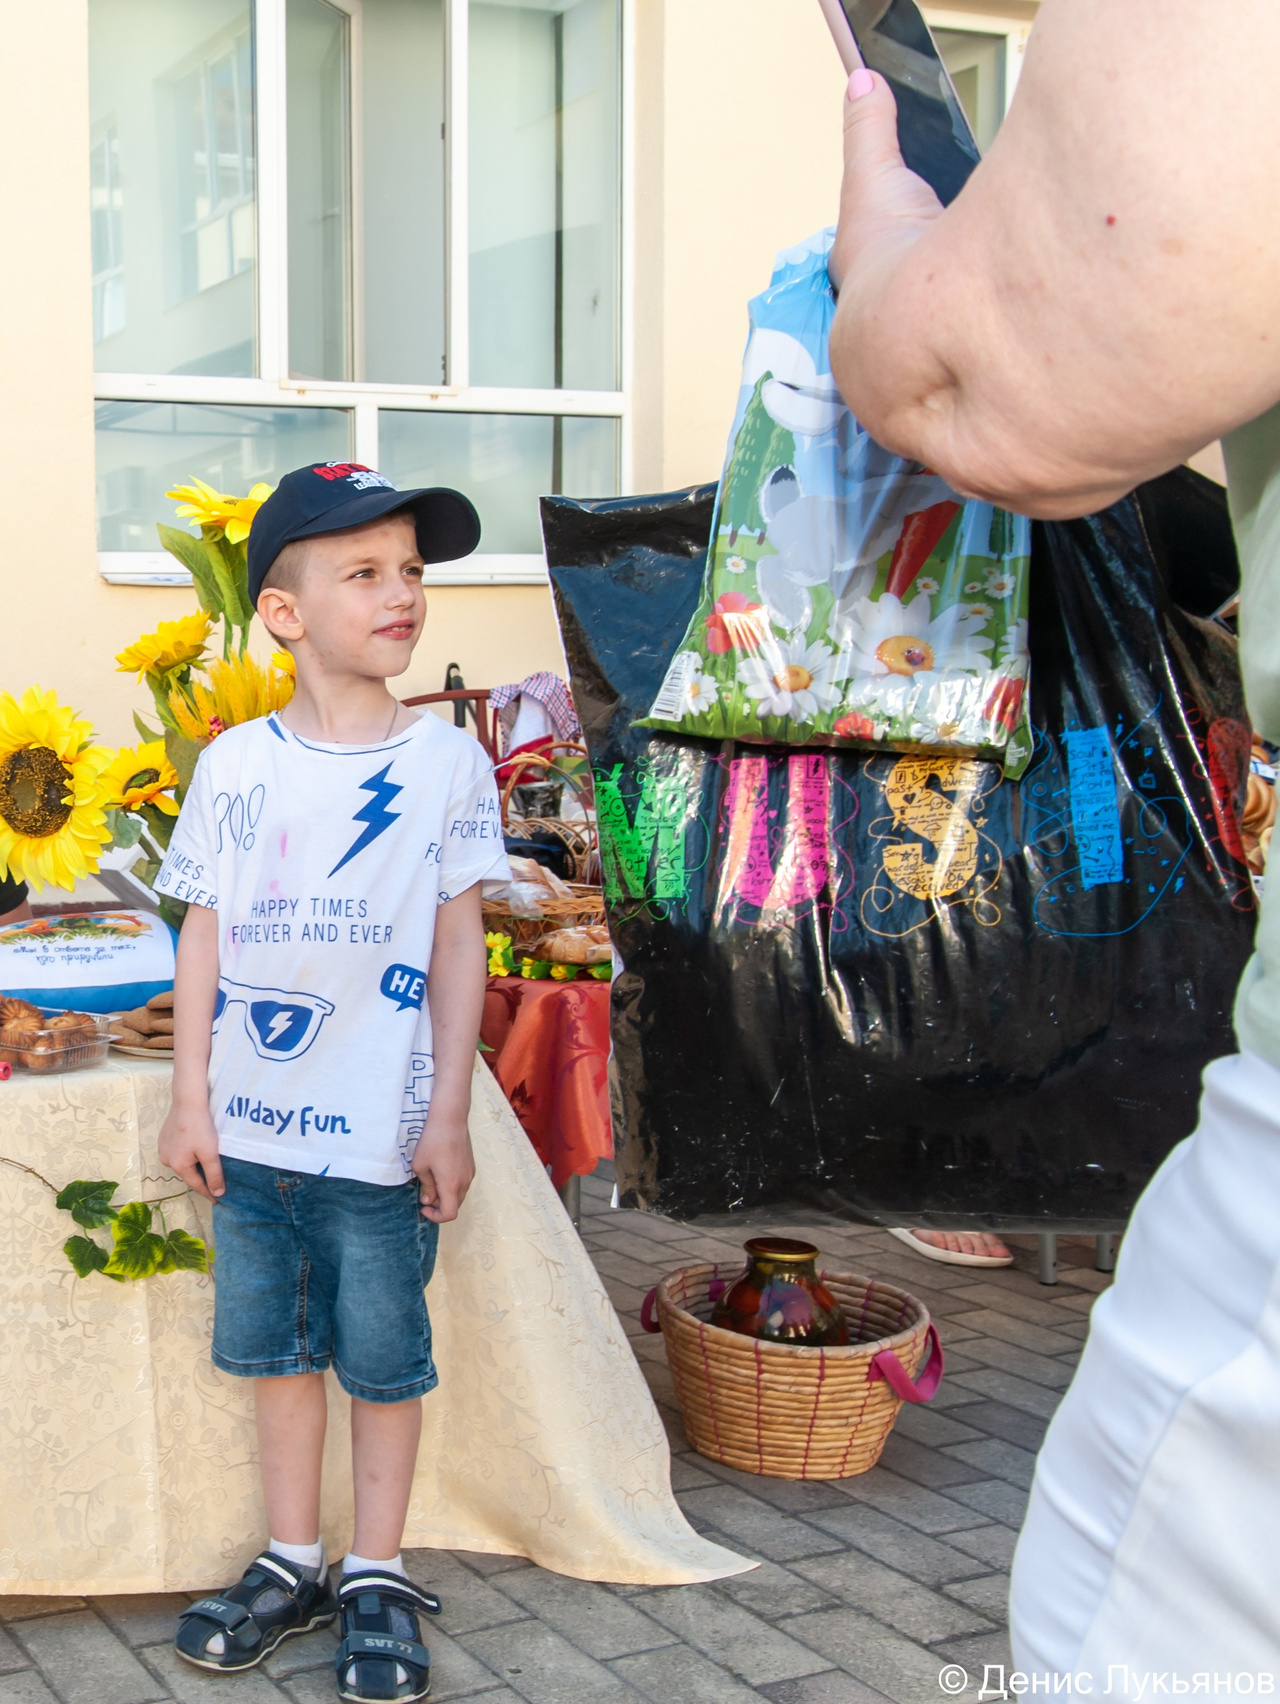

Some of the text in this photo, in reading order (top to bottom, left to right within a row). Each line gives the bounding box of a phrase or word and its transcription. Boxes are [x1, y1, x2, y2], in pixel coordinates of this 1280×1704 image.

[167, 848, 205, 881] TIMES
[251, 898, 368, 919] HAPPY TIMES
[232, 923, 393, 944] FOREVER AND EVER
